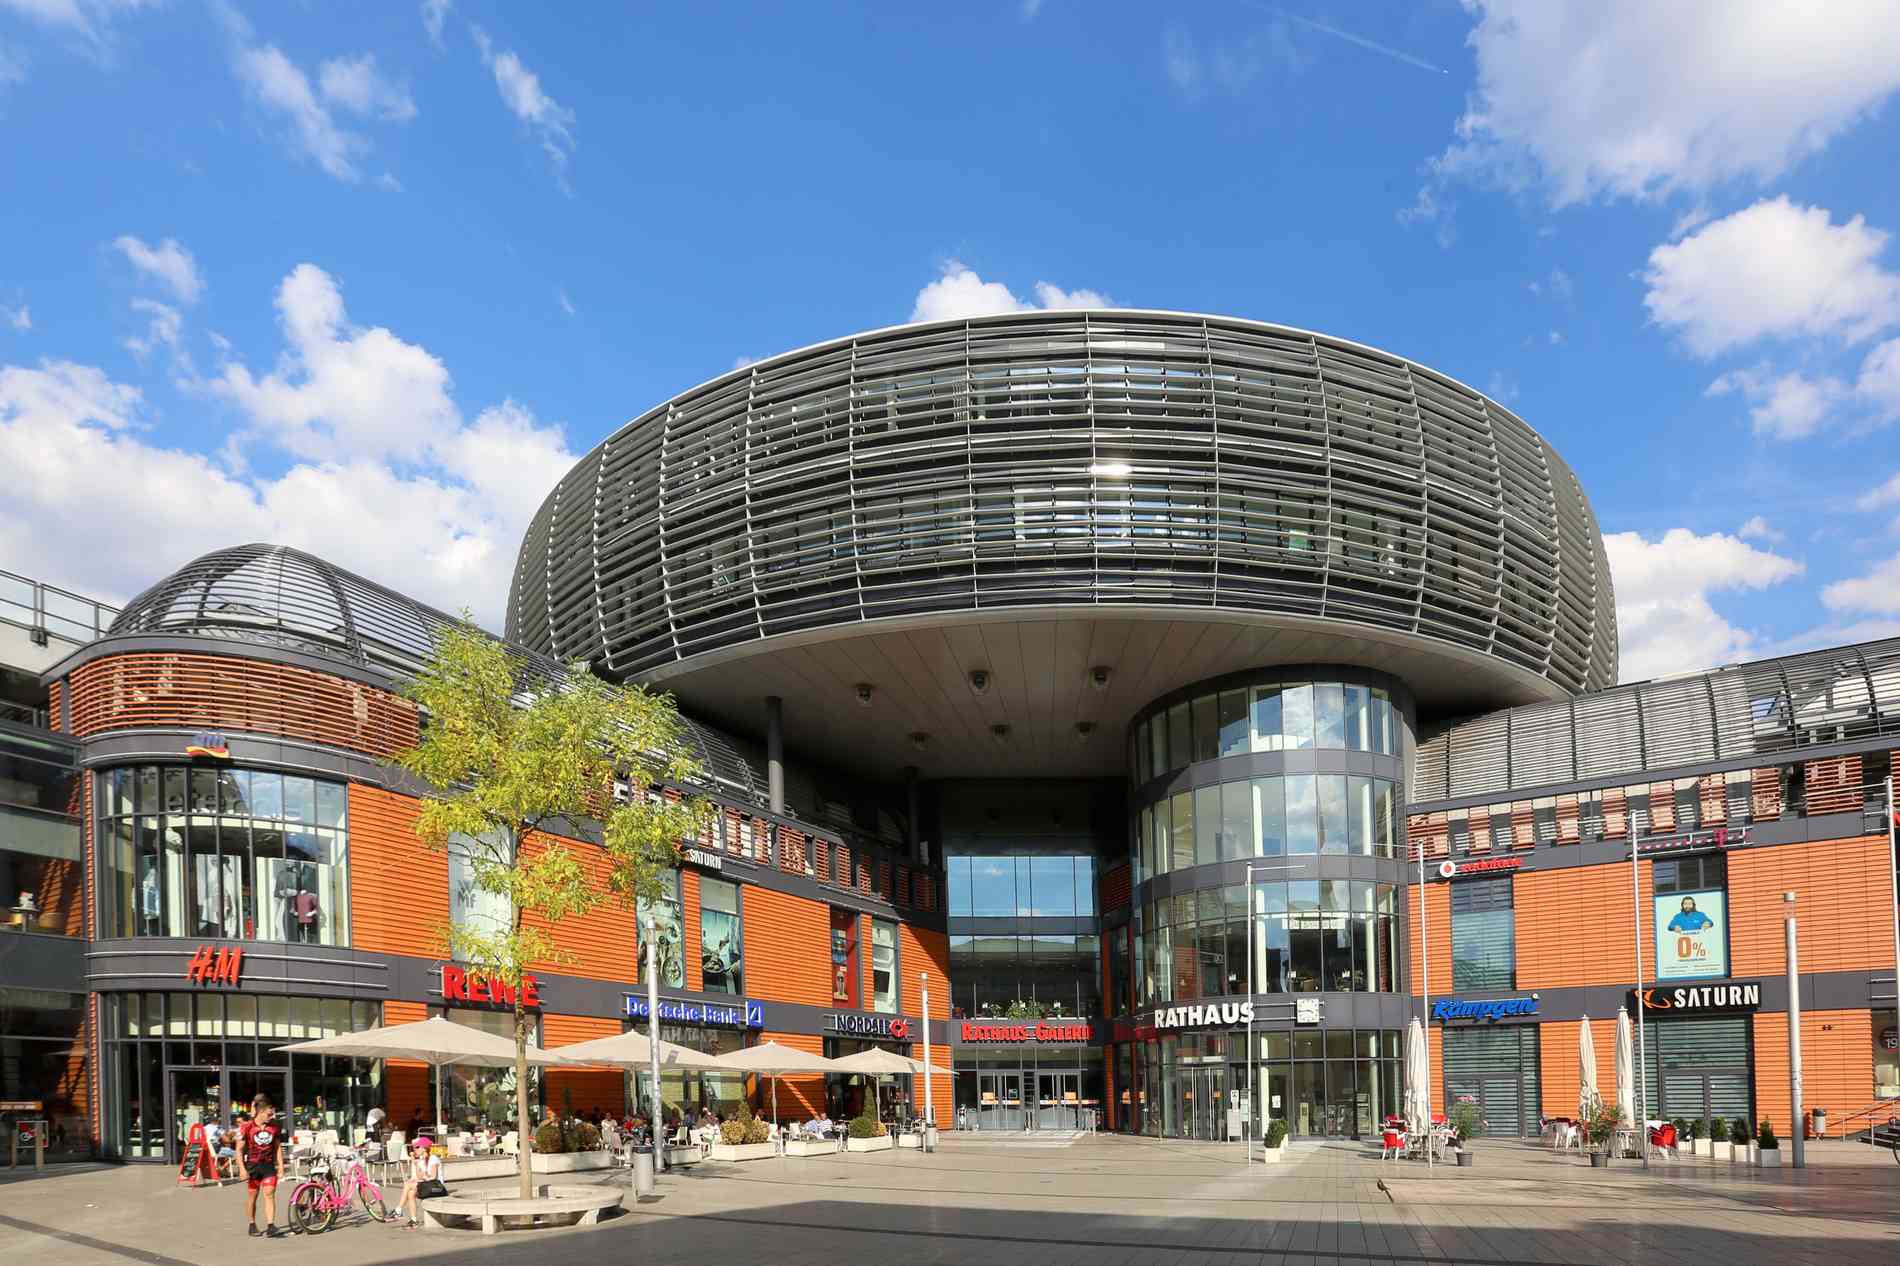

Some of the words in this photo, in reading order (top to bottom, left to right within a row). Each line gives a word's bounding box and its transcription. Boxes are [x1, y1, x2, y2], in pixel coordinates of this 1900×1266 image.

[689, 848, 722, 870] SATURN
[1678, 936, 1706, 958] 0%
[184, 944, 241, 985] H&M
[441, 965, 539, 1007] REWE
[1674, 985, 1759, 1008] SATURN
[626, 996, 700, 1020] Detsche
[703, 1004, 738, 1024] Bank
[1154, 1001, 1255, 1029] RATHAUS
[961, 1022, 1026, 1041] RATHAUS
